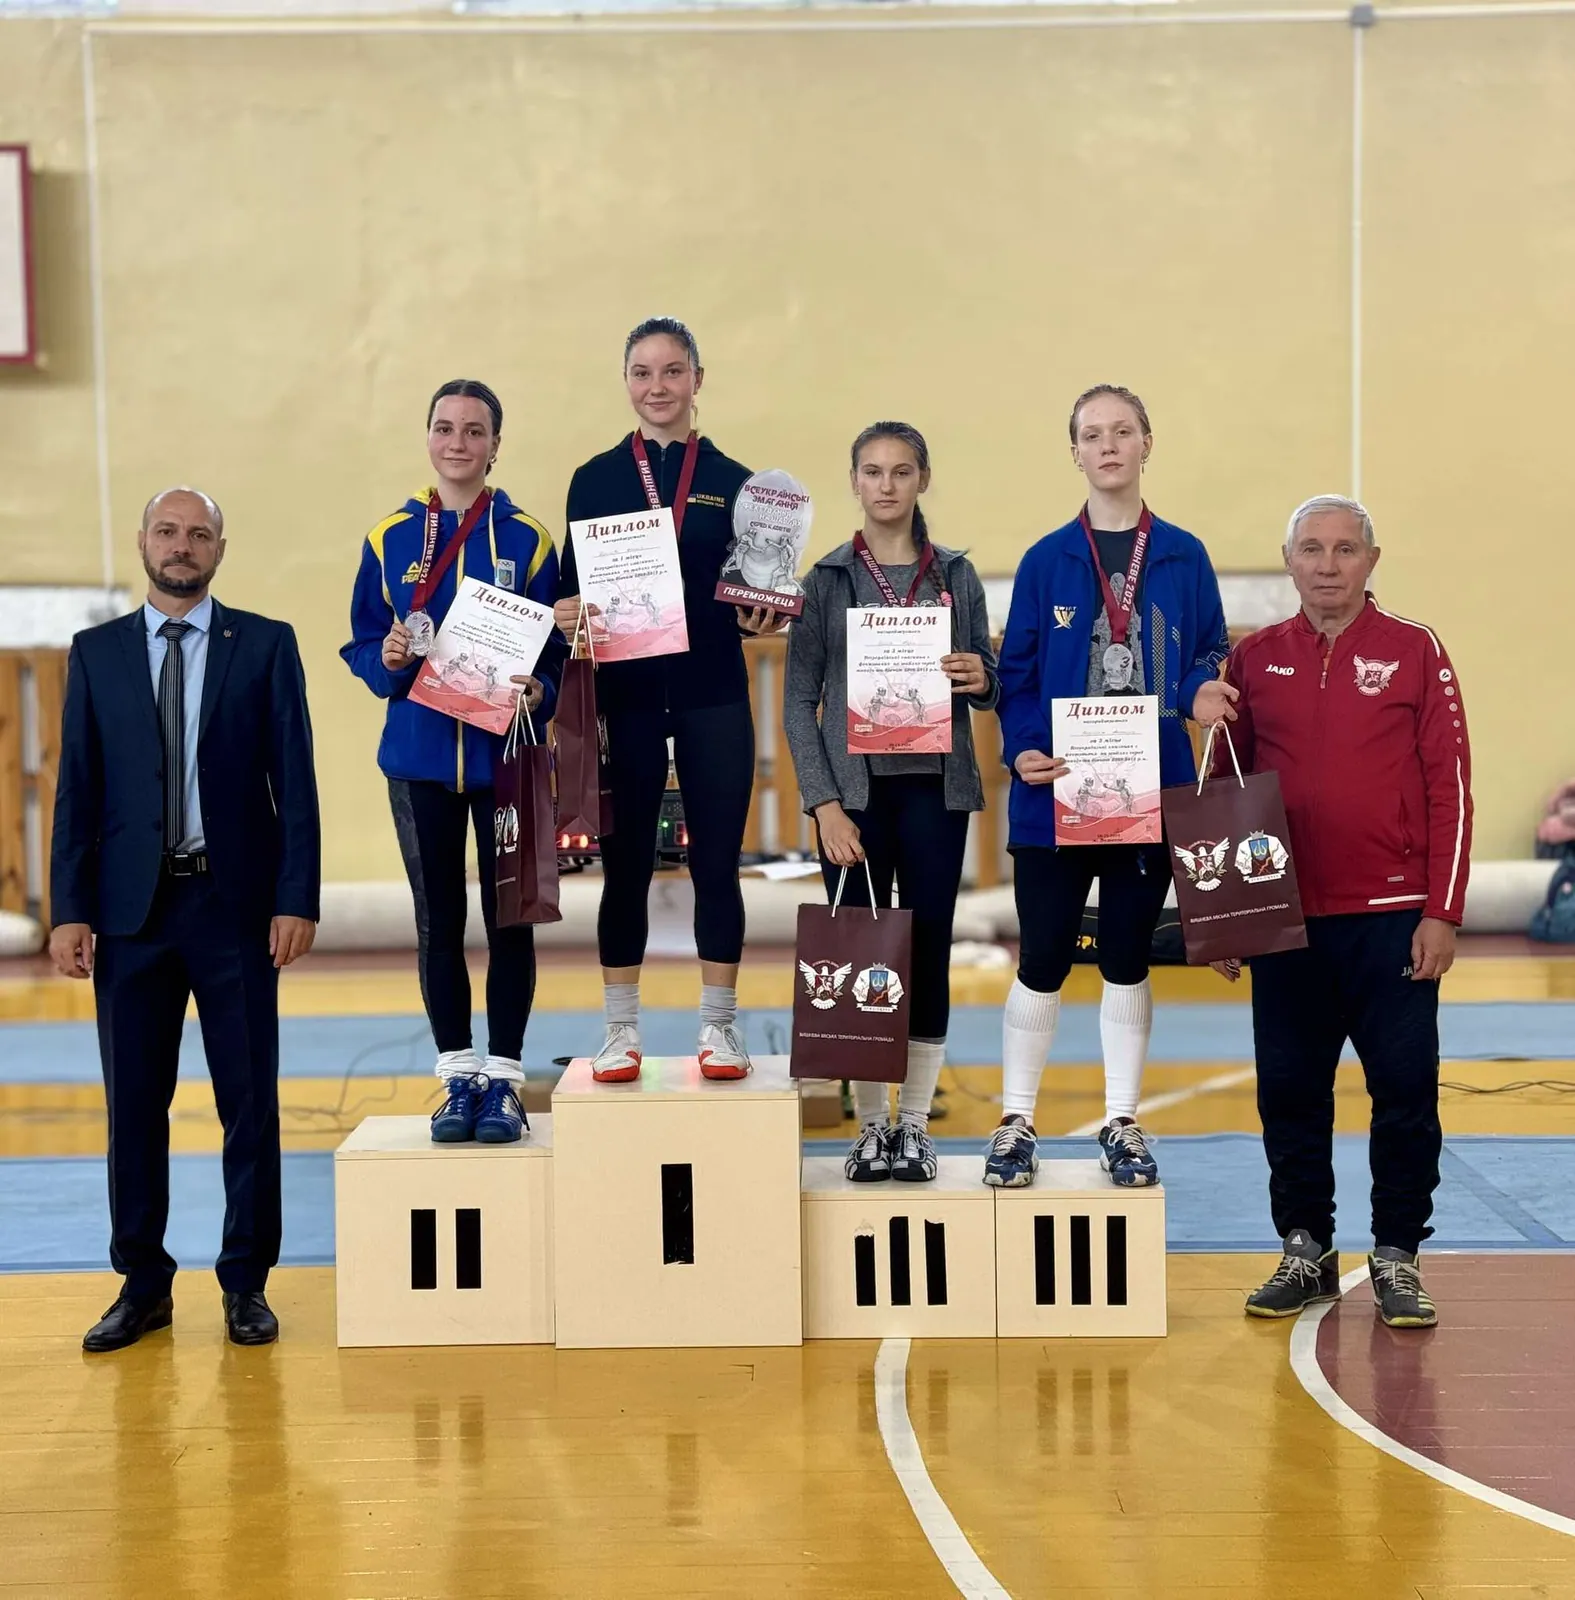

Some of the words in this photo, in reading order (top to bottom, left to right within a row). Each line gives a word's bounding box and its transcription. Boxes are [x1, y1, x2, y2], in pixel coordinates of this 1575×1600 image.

[696, 493, 725, 503] UKRAINE
[744, 484, 810, 503] ВСЕУКРАЇНСЬКІ
[752, 495, 798, 511] ЗМАГАННЯ
[425, 512, 439, 561] ВИШНЕВЕ
[586, 518, 660, 541] Диплом
[1130, 531, 1147, 582] ВИШНЕВЕ
[401, 572, 420, 584] PEA
[418, 562, 431, 584] 2024
[860, 549, 888, 588] ВИШНЕВЕ
[471, 586, 544, 622] Диплом
[723, 586, 796, 608] ПЕРЕМОЖЕЦЬ
[1121, 584, 1135, 612] 2024
[421, 622, 430, 633] 2
[860, 612, 937, 630] Диплом
[1120, 656, 1130, 669] 3
[1265, 664, 1295, 676] JAKO
[1066, 703, 1145, 720] Диплом
